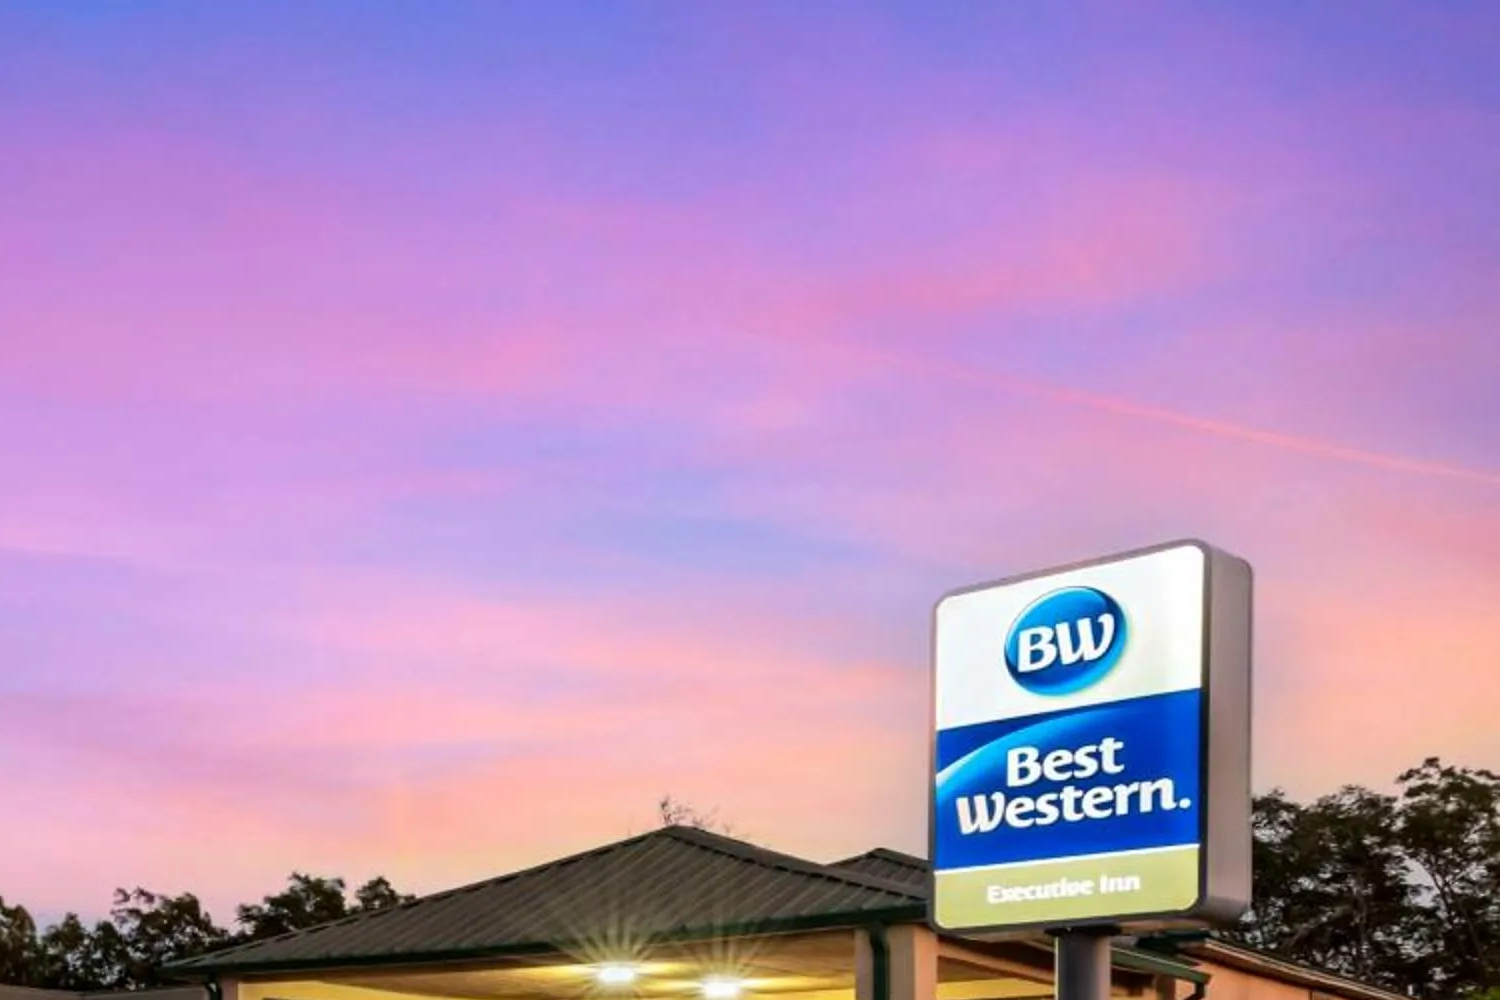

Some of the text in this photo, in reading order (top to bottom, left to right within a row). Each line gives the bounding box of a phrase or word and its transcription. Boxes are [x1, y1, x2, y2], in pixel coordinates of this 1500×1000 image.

[1017, 613, 1115, 673] BW
[1007, 737, 1125, 787] Best
[987, 874, 1141, 904] Executive Inn
